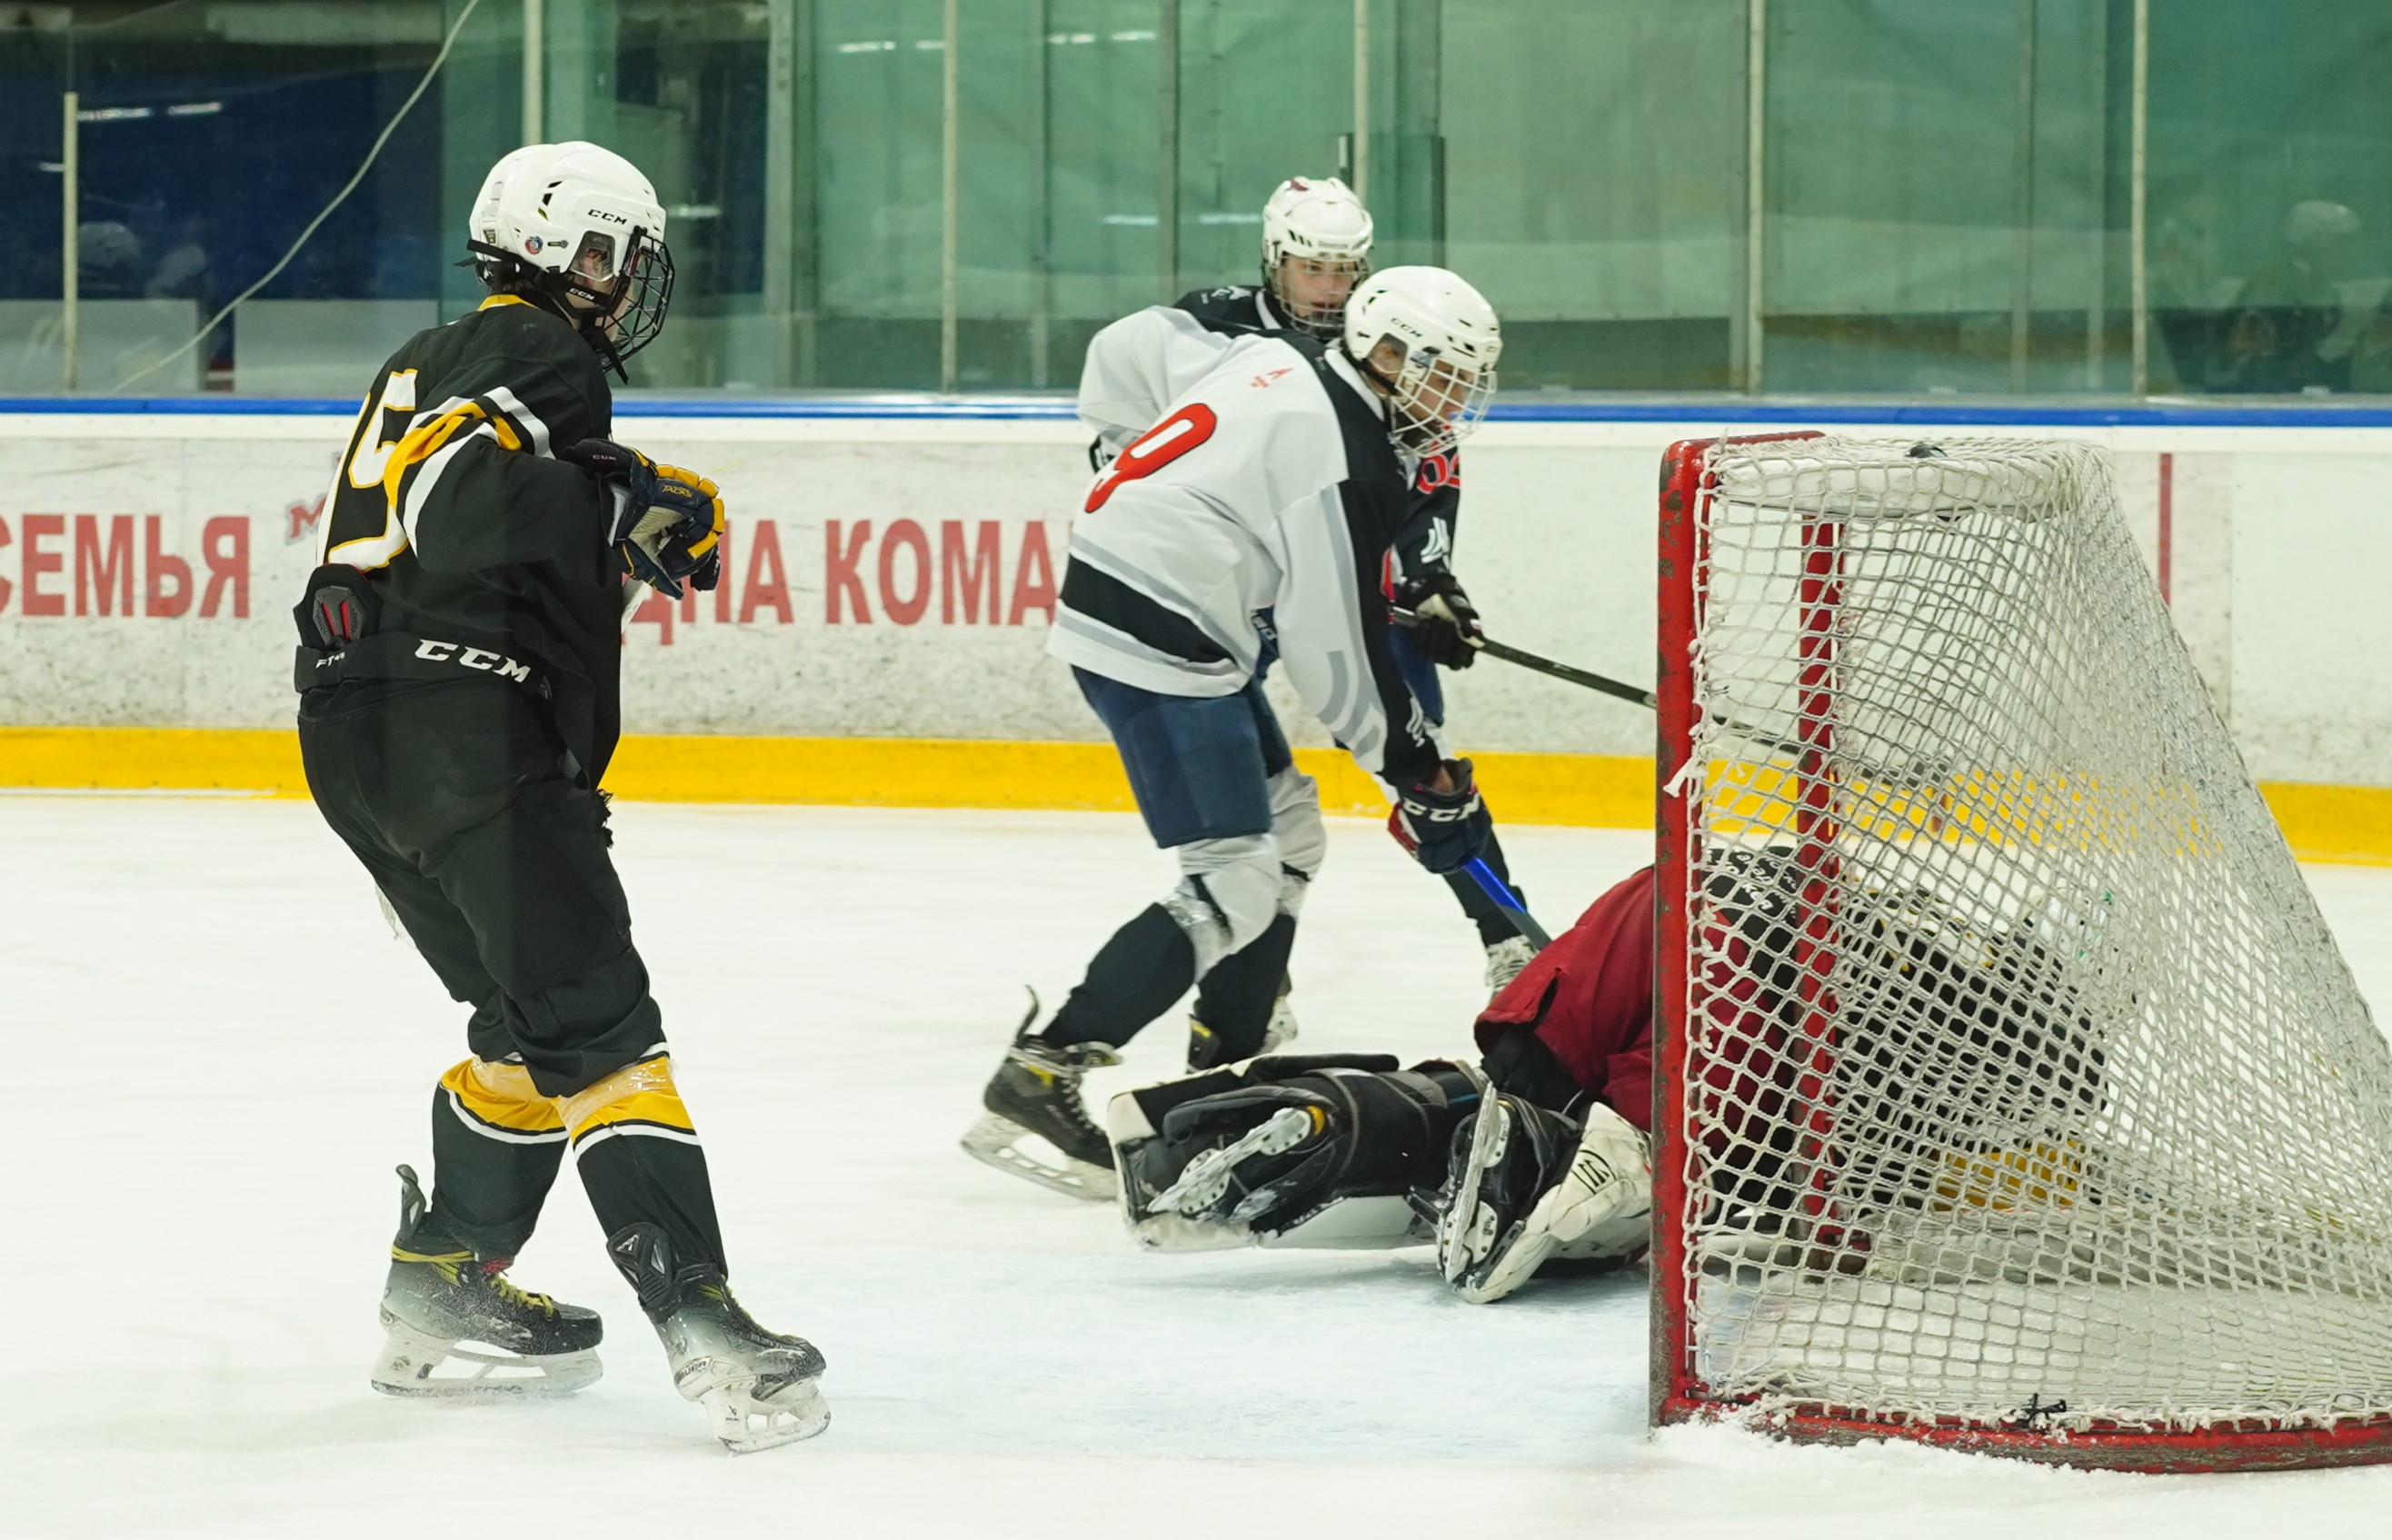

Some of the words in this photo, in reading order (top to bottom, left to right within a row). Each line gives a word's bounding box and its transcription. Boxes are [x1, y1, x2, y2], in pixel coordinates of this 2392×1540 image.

[588, 209, 628, 225] CCM
[570, 287, 595, 301] CCM
[1390, 317, 1422, 337] CCM
[0, 513, 250, 620] ЕМЬЯ
[824, 519, 1072, 625] КОМА
[414, 639, 531, 682] CCM
